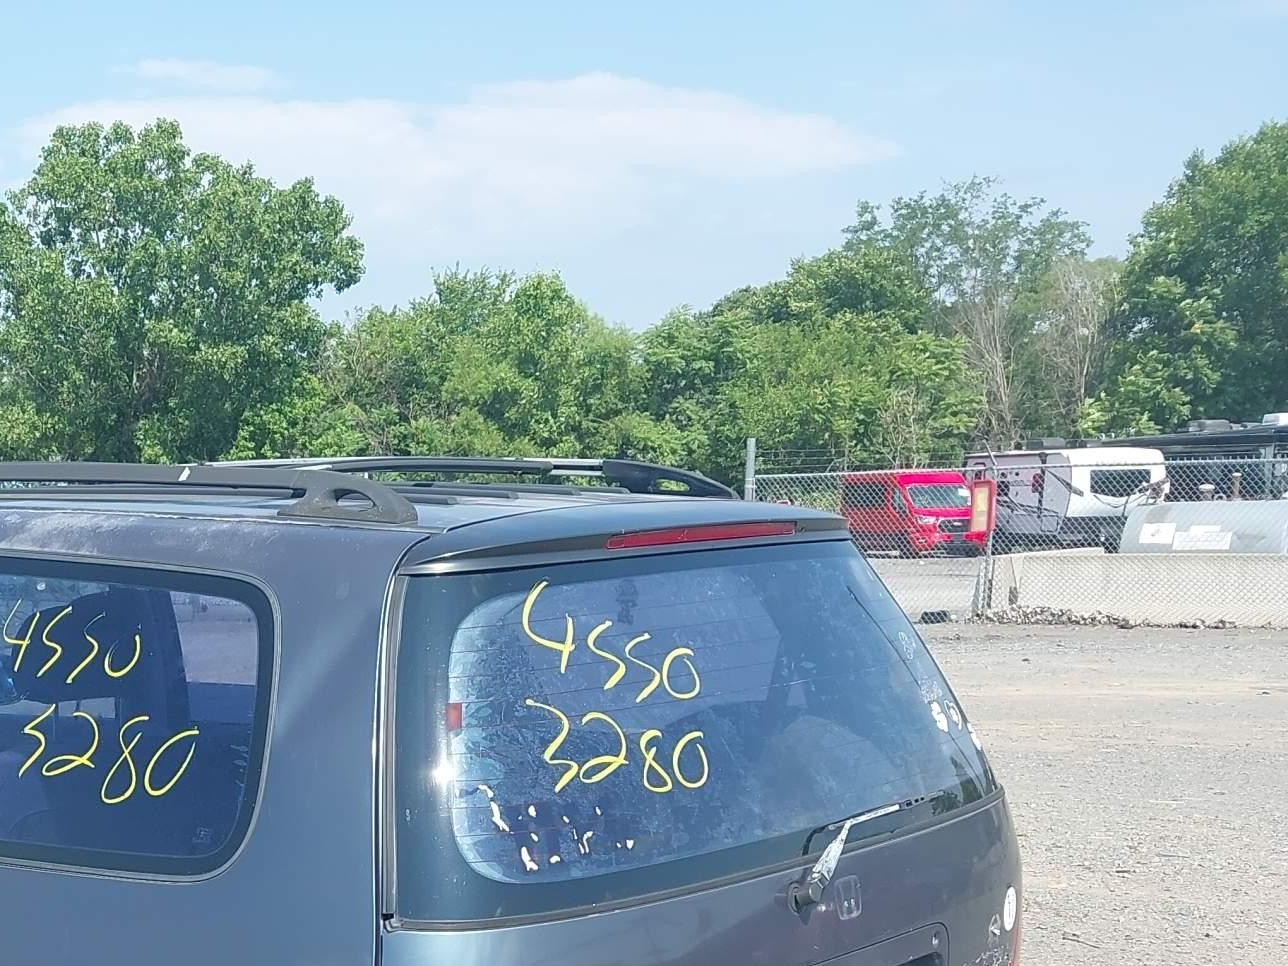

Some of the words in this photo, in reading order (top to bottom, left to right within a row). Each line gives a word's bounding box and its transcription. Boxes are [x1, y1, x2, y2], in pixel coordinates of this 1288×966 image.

[2, 598, 142, 684] 4550
[520, 579, 702, 704] 4550
[525, 697, 710, 794] 3280
